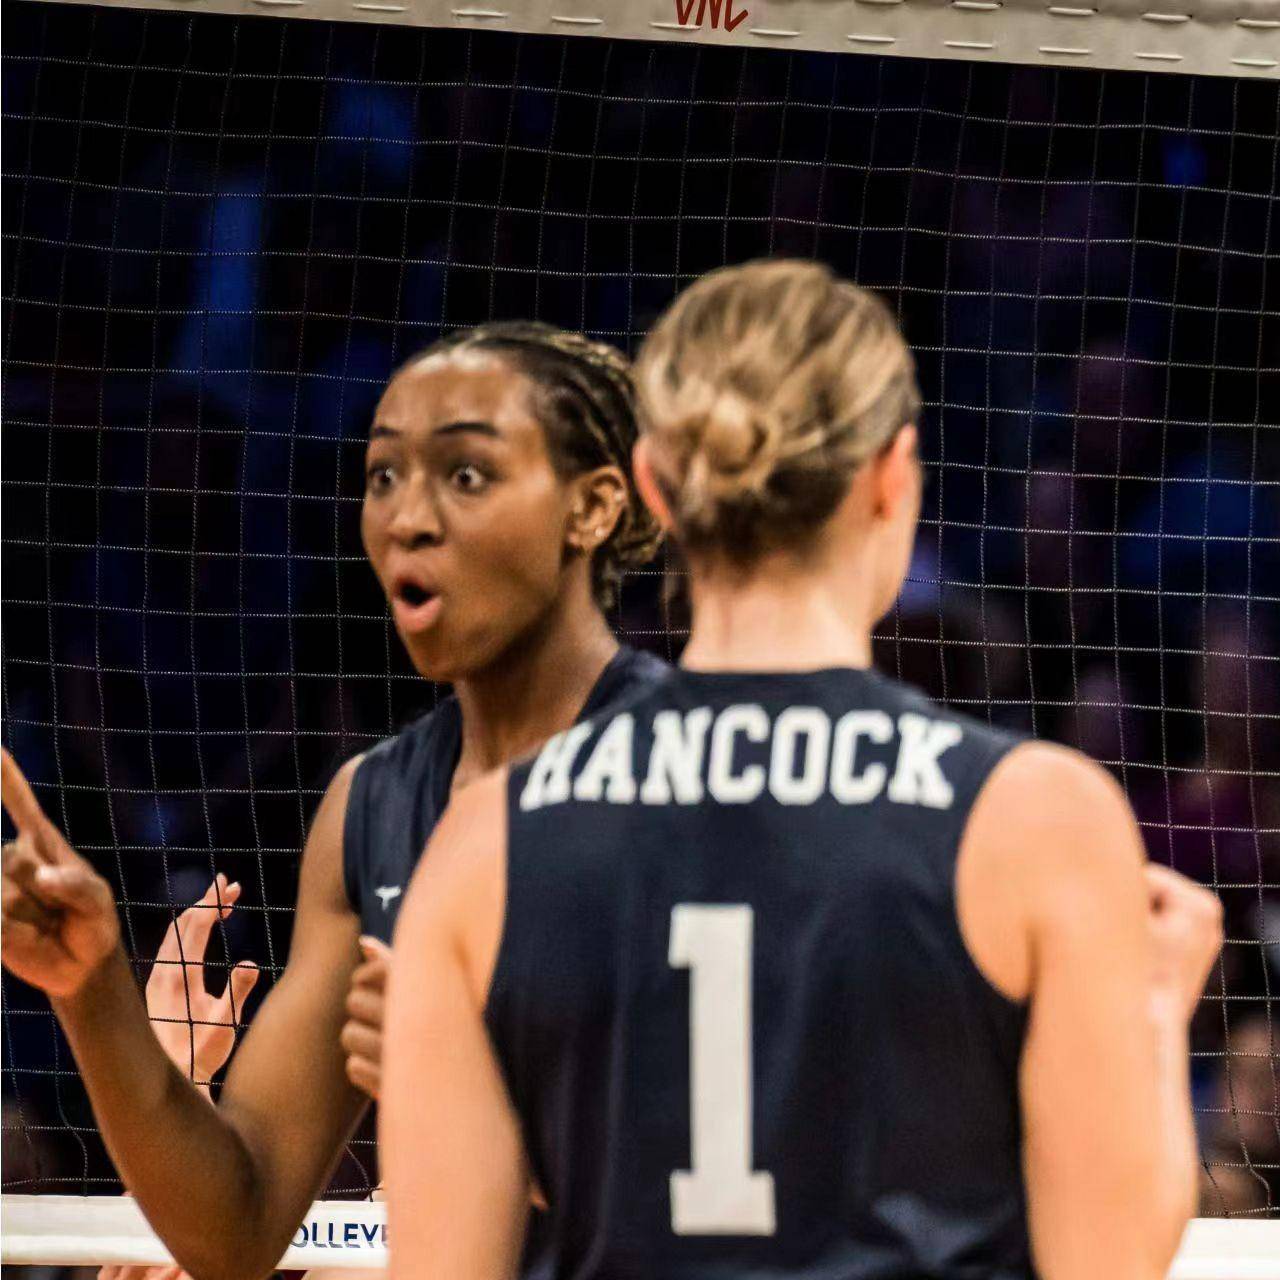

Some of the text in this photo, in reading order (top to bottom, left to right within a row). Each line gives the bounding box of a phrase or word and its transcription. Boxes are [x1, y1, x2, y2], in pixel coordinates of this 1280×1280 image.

[519, 704, 963, 812] HANCOCK
[667, 903, 777, 1236] 1
[290, 1222, 388, 1249] OLLEY
